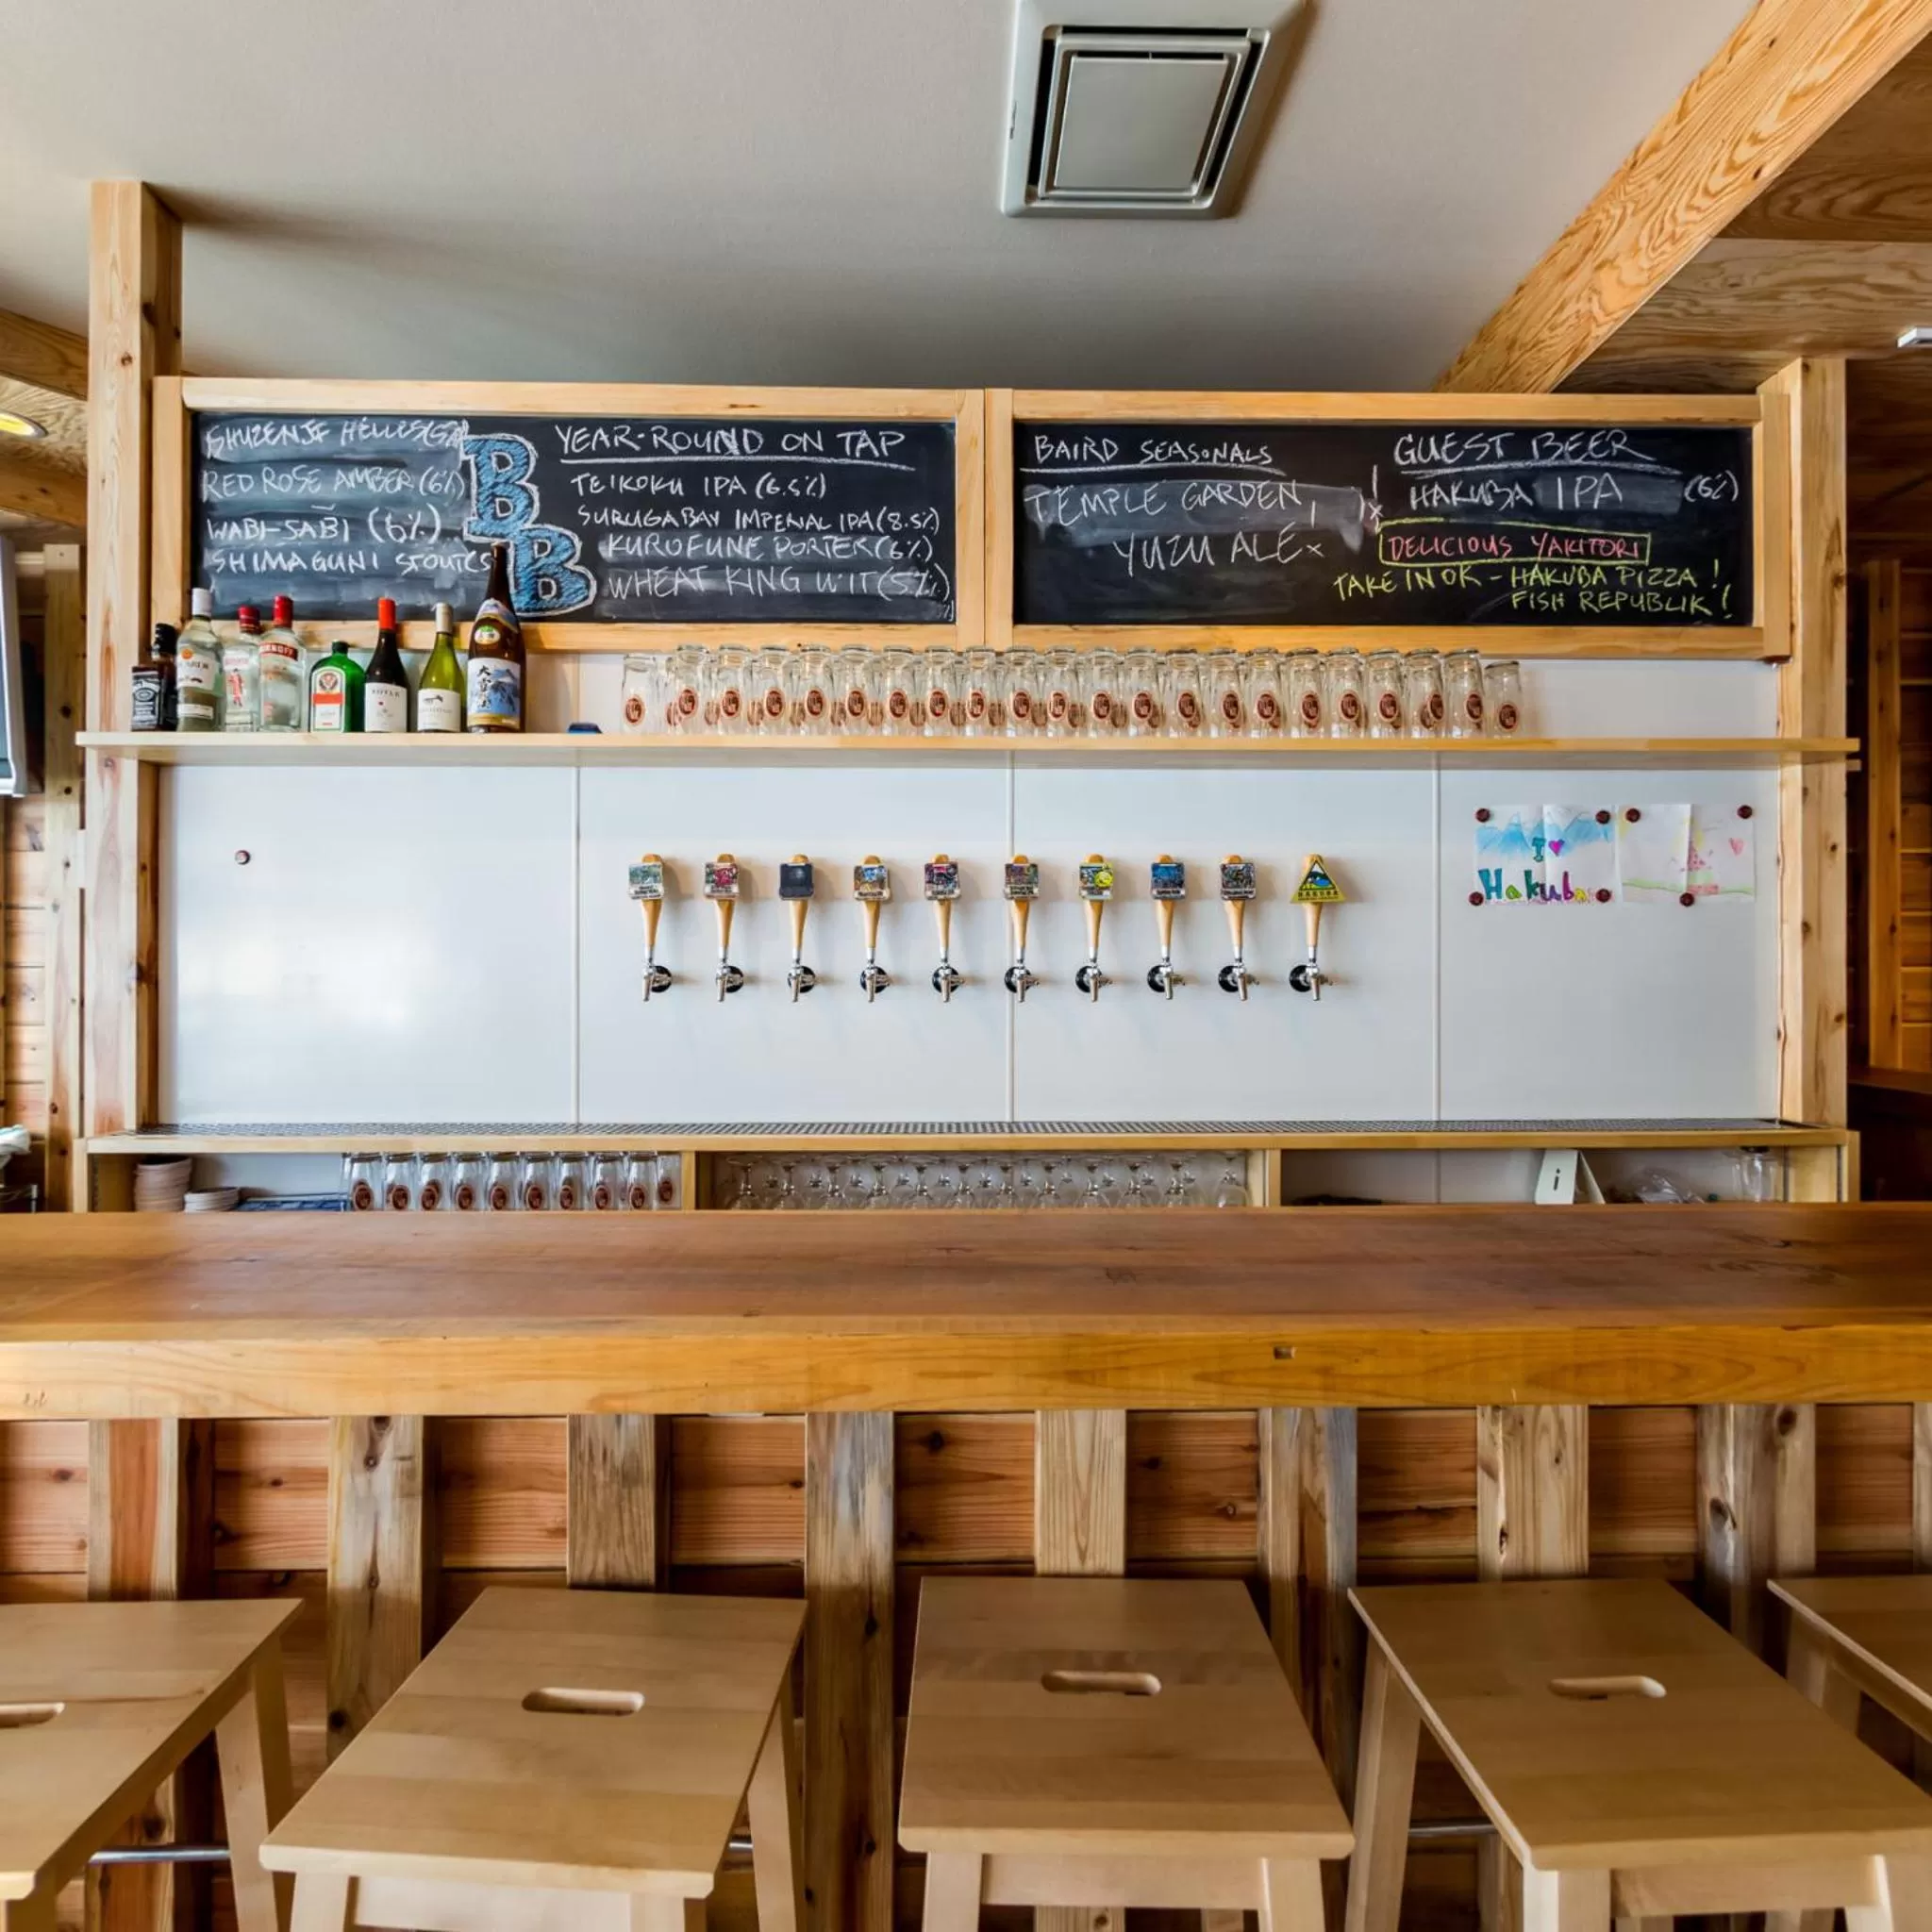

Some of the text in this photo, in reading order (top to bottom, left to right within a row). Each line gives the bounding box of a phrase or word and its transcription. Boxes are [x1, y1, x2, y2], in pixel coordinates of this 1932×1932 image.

[555, 425, 906, 458] YEAR-ROUND ON TAP
[1034, 435, 1274, 465] BAIRD SEASONALS
[1394, 429, 1657, 466] GUEST BEER
[202, 469, 255, 503] RED
[262, 464, 322, 494] ROSE
[334, 467, 415, 494] AMBER
[570, 472, 826, 499] TEIKOKU IPA (6.5%)
[1409, 477, 1533, 511] HAKUBA
[1557, 474, 1624, 510] IPA
[1024, 481, 1168, 526] TEMPLE
[207, 516, 349, 543] WABI-SABI
[1388, 532, 1640, 560] DELICIOUS YAKITORI
[211, 549, 378, 574] SHIMAGUNI
[608, 532, 763, 561] KUROFUNE
[773, 535, 874, 559] PORTER
[1112, 522, 1303, 577] YUZU ALE
[608, 565, 709, 600] WHEAT
[725, 564, 801, 598] KING
[1333, 571, 1397, 601] TAKE
[1406, 569, 1436, 591] IN
[1441, 565, 1483, 589] OK
[1511, 565, 1607, 589] HAKUBA
[1511, 590, 1566, 610] FISH
[1530, 837, 1546, 862] I
[1477, 868, 1589, 902] Hakuba
